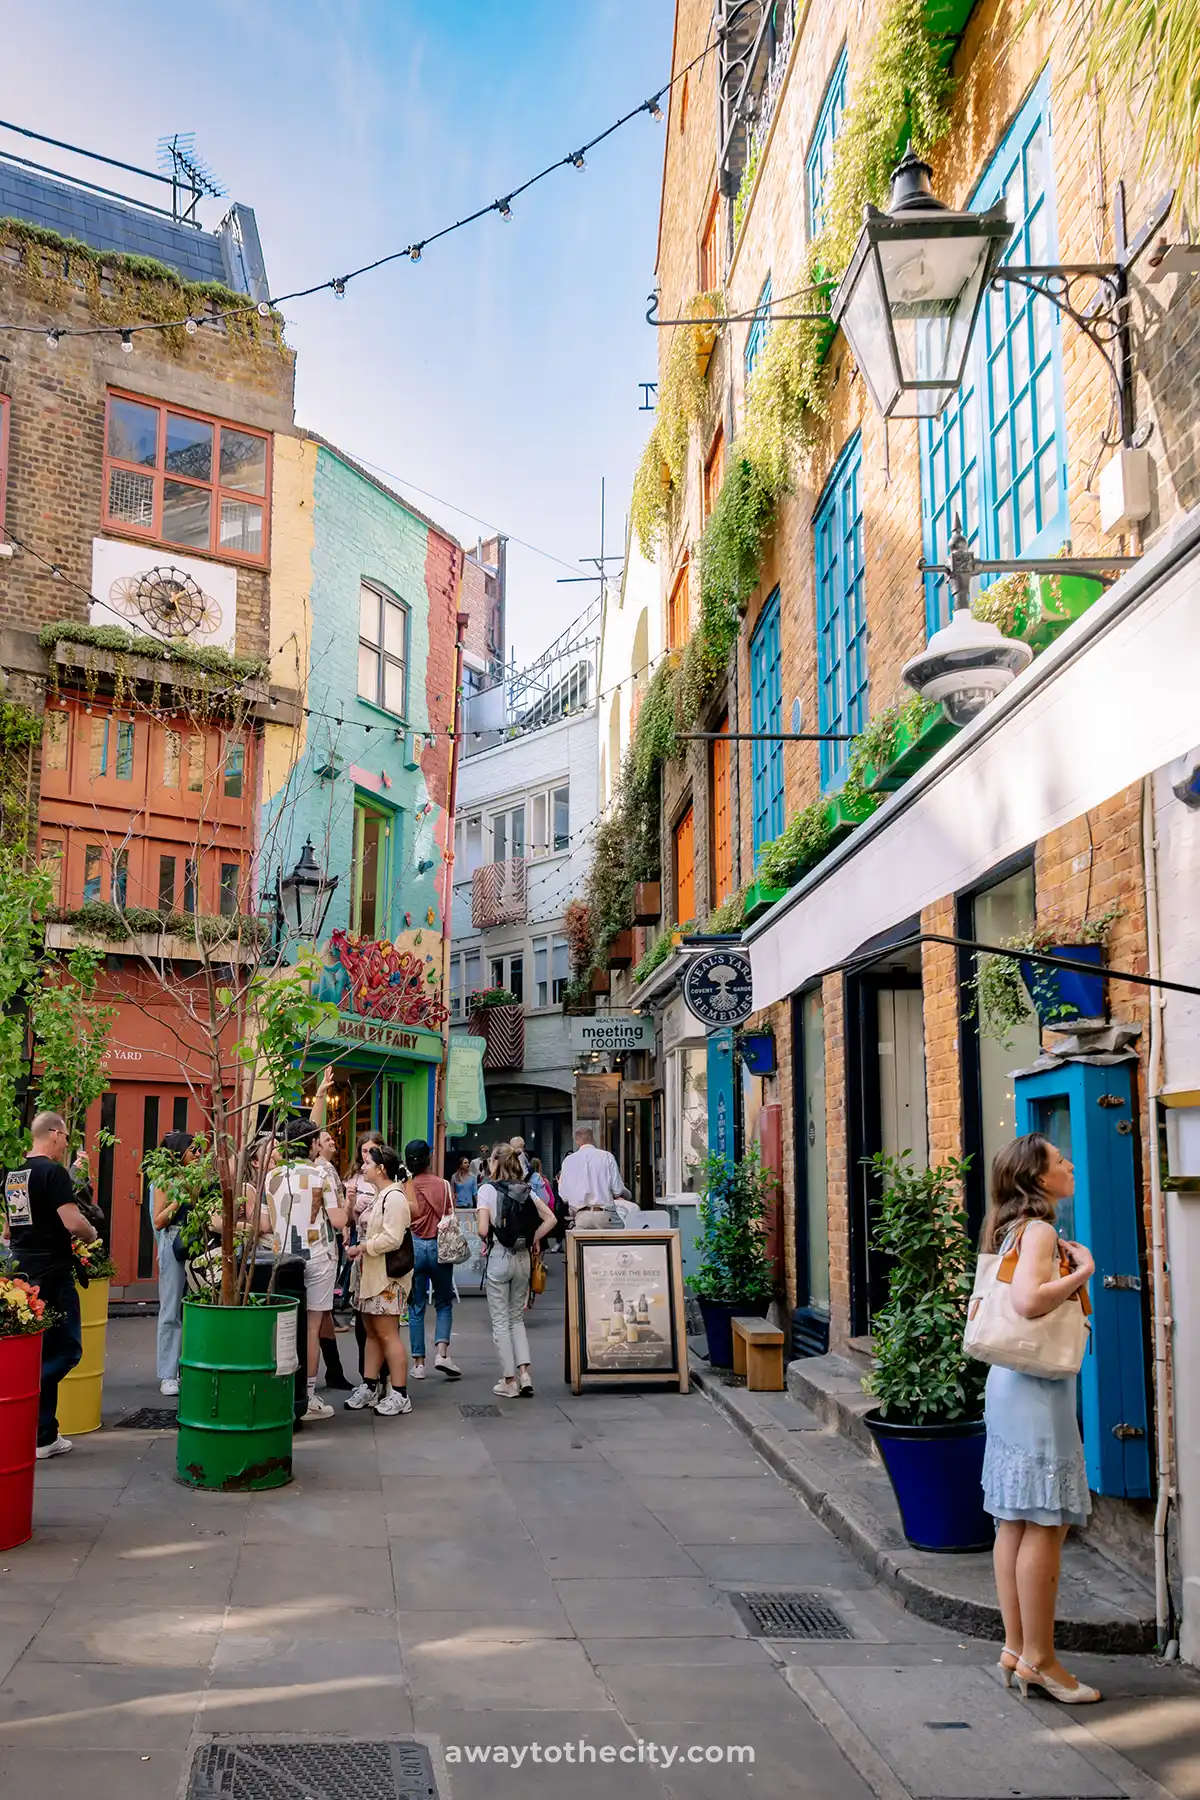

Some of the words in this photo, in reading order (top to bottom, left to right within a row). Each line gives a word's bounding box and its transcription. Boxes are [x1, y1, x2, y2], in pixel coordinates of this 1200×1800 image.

[690, 954, 725, 986] NEAL'S
[728, 956, 753, 984] YARD
[690, 987, 714, 995] COVENT
[693, 994, 753, 1021] REMEDIES
[338, 1020, 367, 1039] HAIR
[386, 1030, 418, 1049] FAIRY
[582, 1024, 644, 1040] meeting
[590, 1037, 636, 1049] rooms
[114, 1049, 142, 1060] YARD
